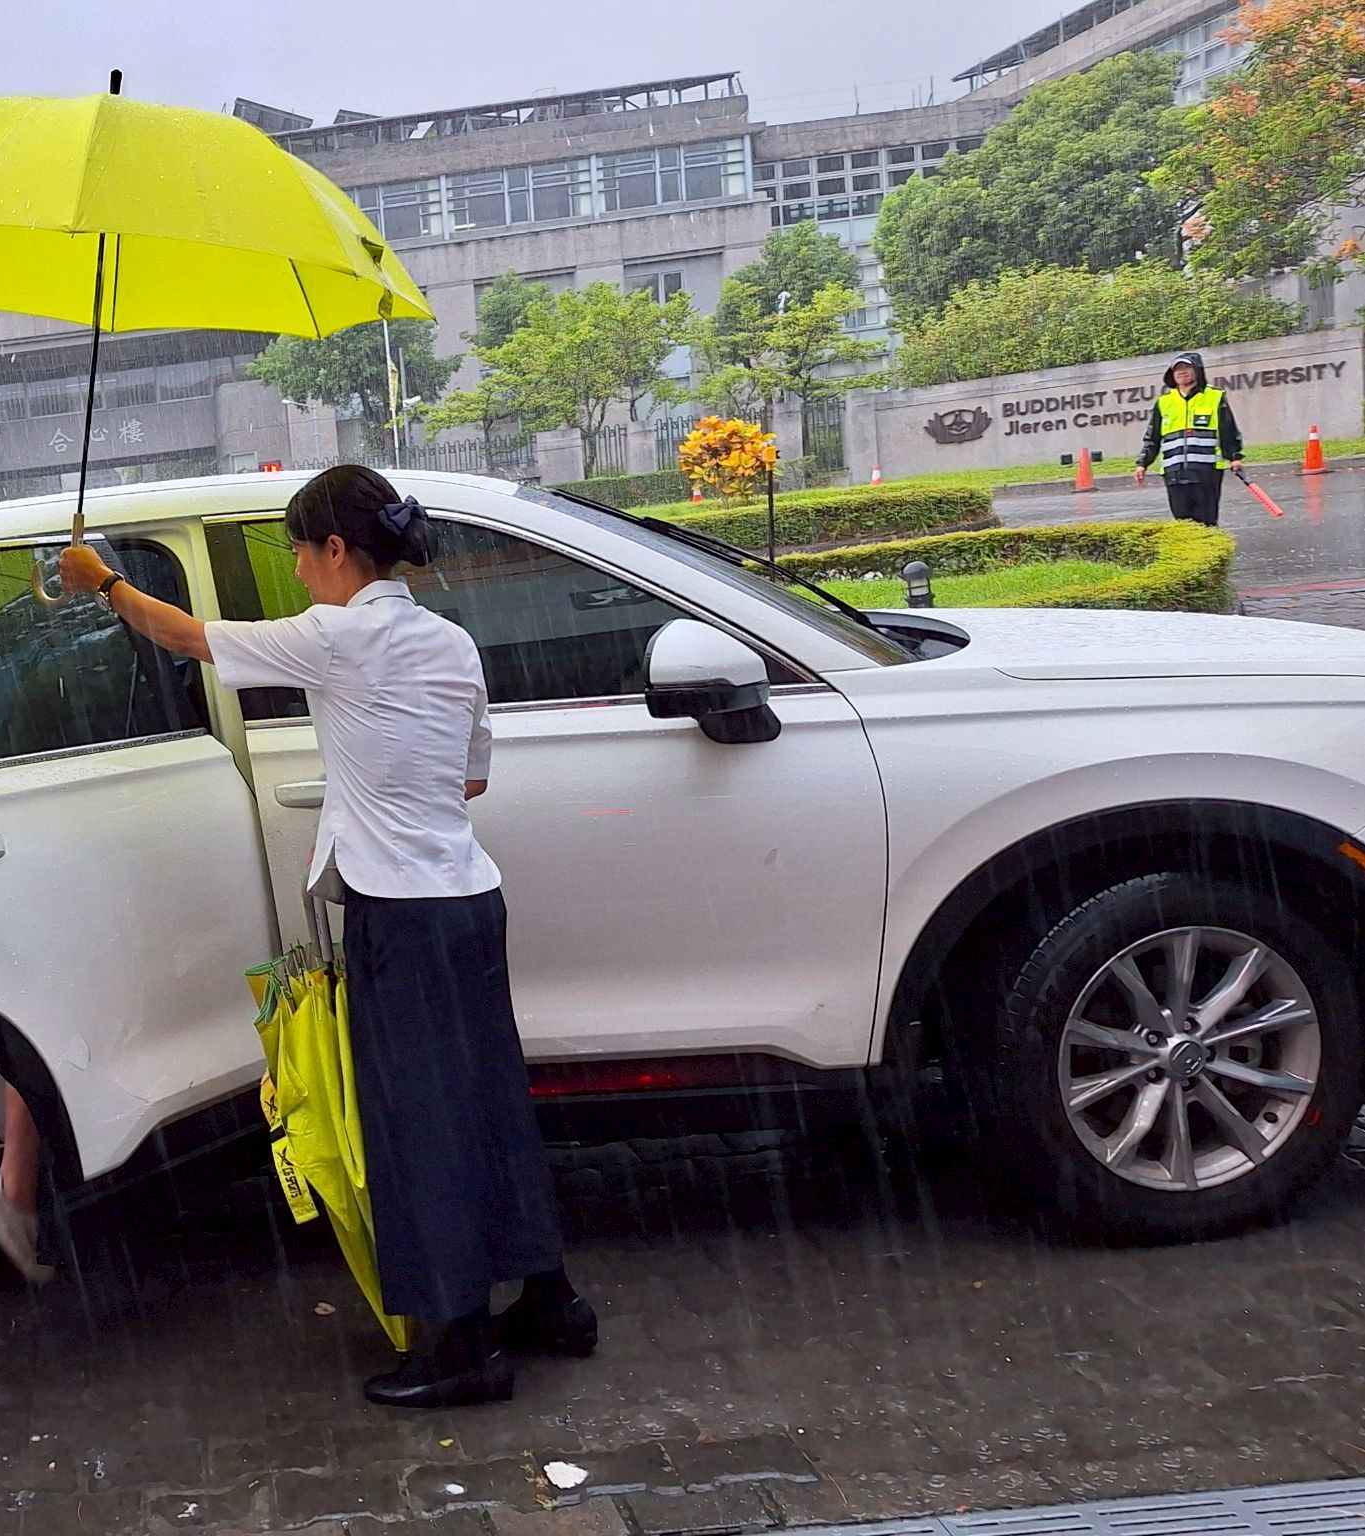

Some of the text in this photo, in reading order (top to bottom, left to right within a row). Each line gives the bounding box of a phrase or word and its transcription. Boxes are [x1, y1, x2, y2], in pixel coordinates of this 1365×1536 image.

[1001, 391, 1107, 418] BUDDHIST
[1113, 385, 1155, 404] TZU
[48, 418, 145, 453] 合心樓
[1004, 409, 1153, 436] Jieren Campu
